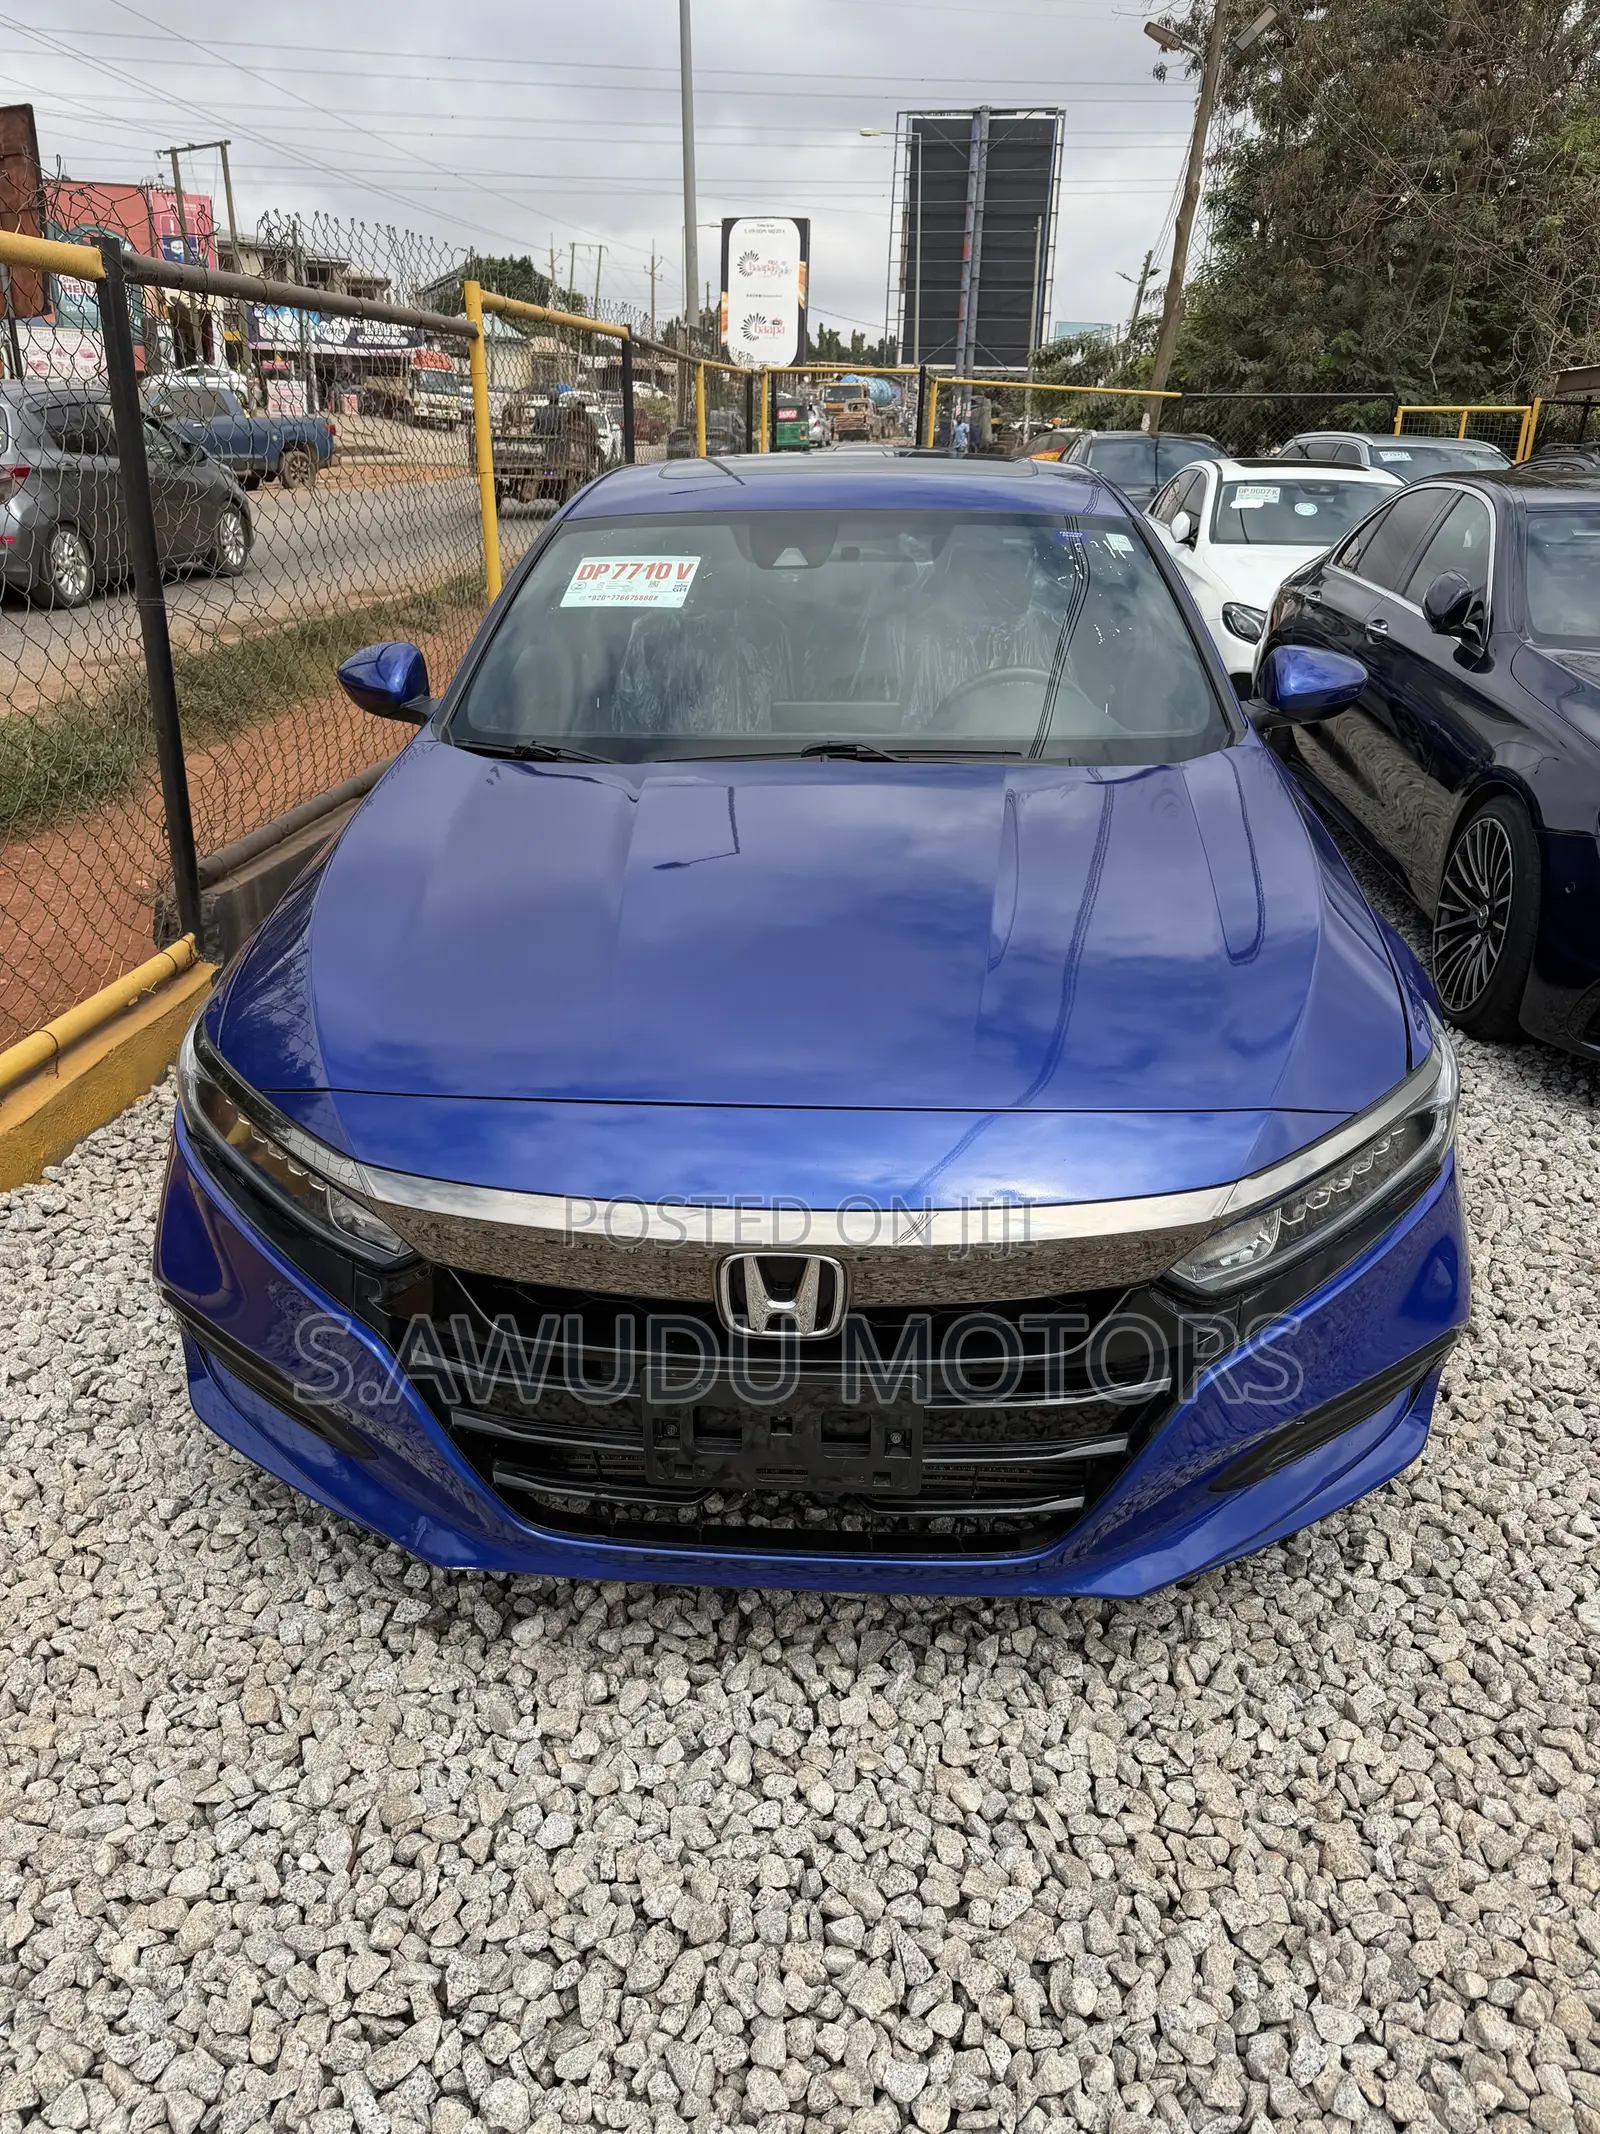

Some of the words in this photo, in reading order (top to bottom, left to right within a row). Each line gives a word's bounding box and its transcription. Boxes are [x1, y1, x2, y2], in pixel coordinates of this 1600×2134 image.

[577, 563, 611, 580] DP
[611, 561, 673, 580] 7710
[676, 563, 694, 580] V
